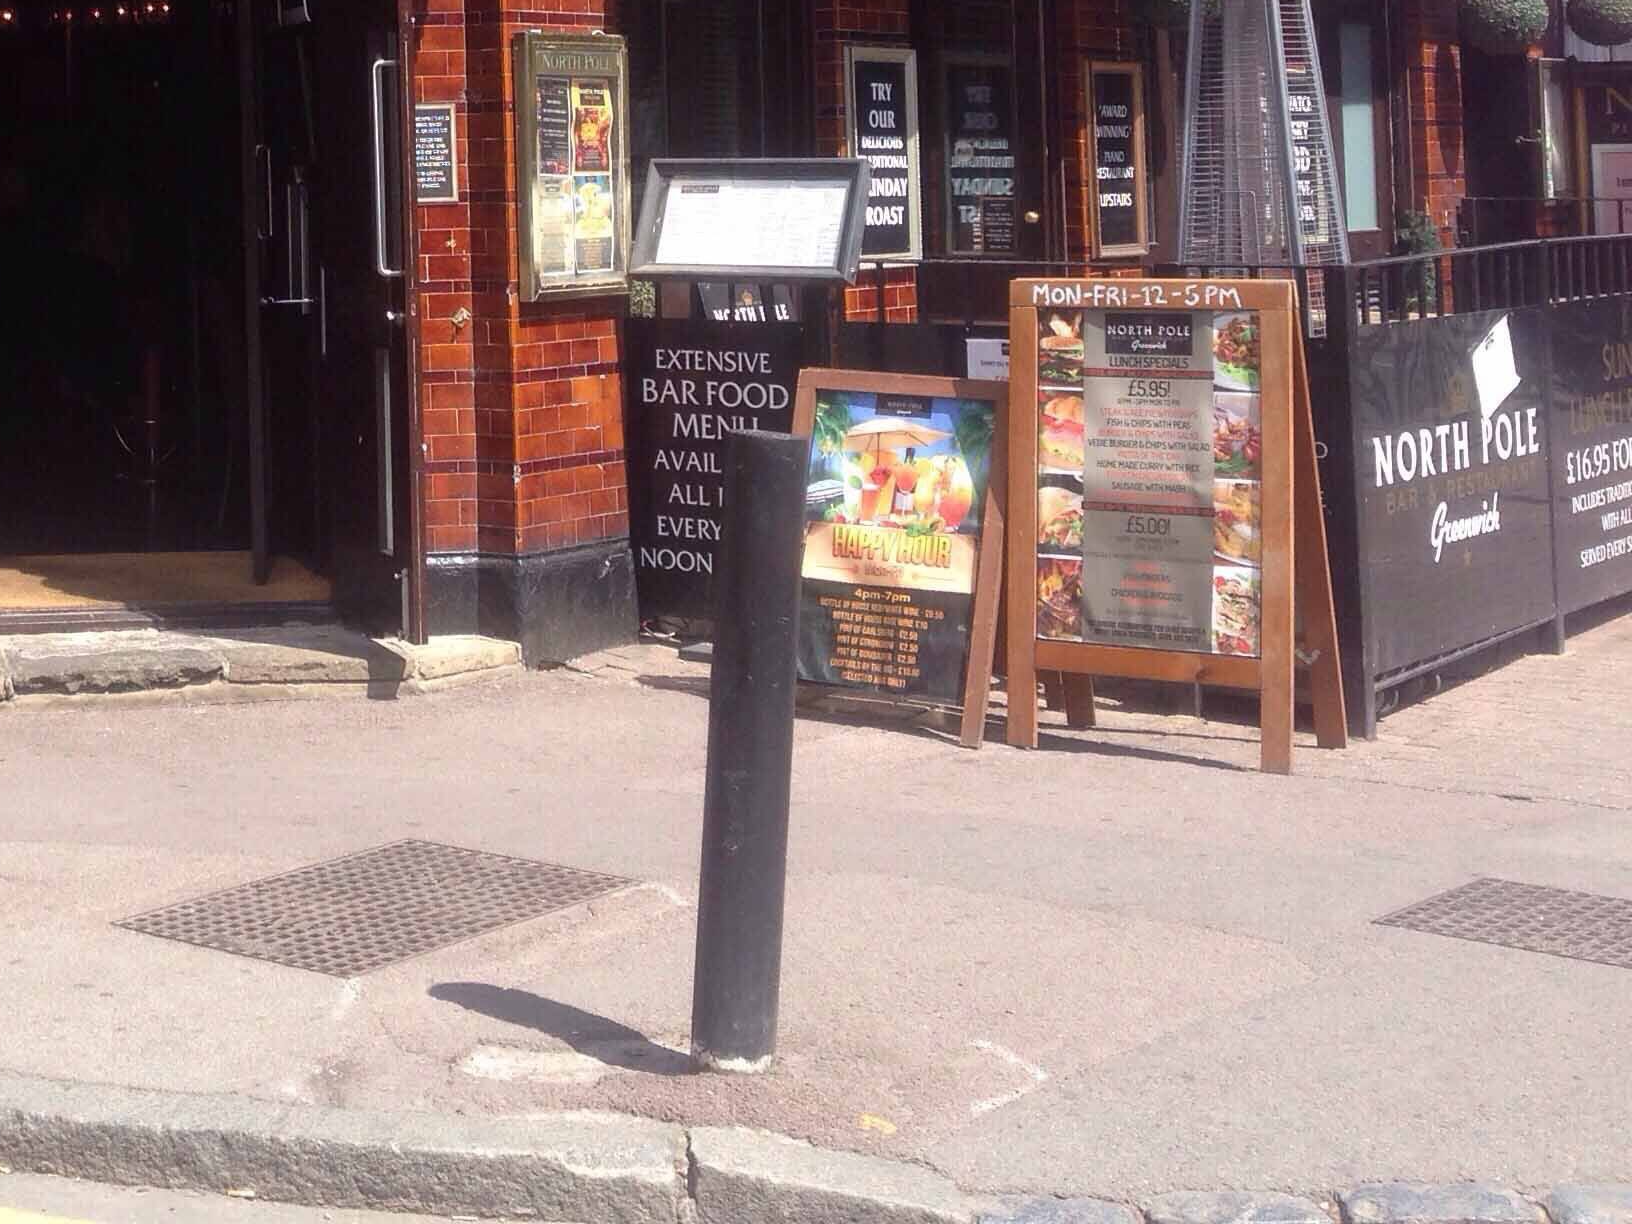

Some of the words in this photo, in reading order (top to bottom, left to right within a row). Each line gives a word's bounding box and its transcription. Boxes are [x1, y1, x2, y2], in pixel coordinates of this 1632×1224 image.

[871, 83, 892, 102] TRY
[869, 110, 895, 128] OUR
[861, 136, 903, 150] DELICIOUS
[1103, 151, 1125, 163] PIANO
[865, 206, 904, 226] ROAST
[1107, 325, 1152, 336] NORTH
[1158, 326, 1190, 336] POLE
[655, 349, 772, 374] EXTENSIVE
[1108, 356, 1143, 367] LUNCH
[1144, 357, 1189, 369] SPECIALS
[642, 379, 699, 406] BAR
[707, 381, 789, 409] FOOD
[1128, 379, 1170, 397] £5.95!
[1373, 421, 1470, 487] NORTH
[1482, 408, 1539, 464] POLE
[1567, 443, 1610, 484] £16.95
[669, 484, 711, 506] ALL
[1572, 490, 1605, 514] INCLUDES
[657, 516, 722, 541] EVERY
[1431, 491, 1500, 563] Greenwich
[1601, 512, 1619, 531] WITH
[832, 527, 893, 562] HAPPY
[897, 533, 951, 568] HOUR
[1580, 543, 1606, 568] SERVED
[641, 548, 713, 575] NOON
[854, 588, 911, 603] 4pm-7pm
